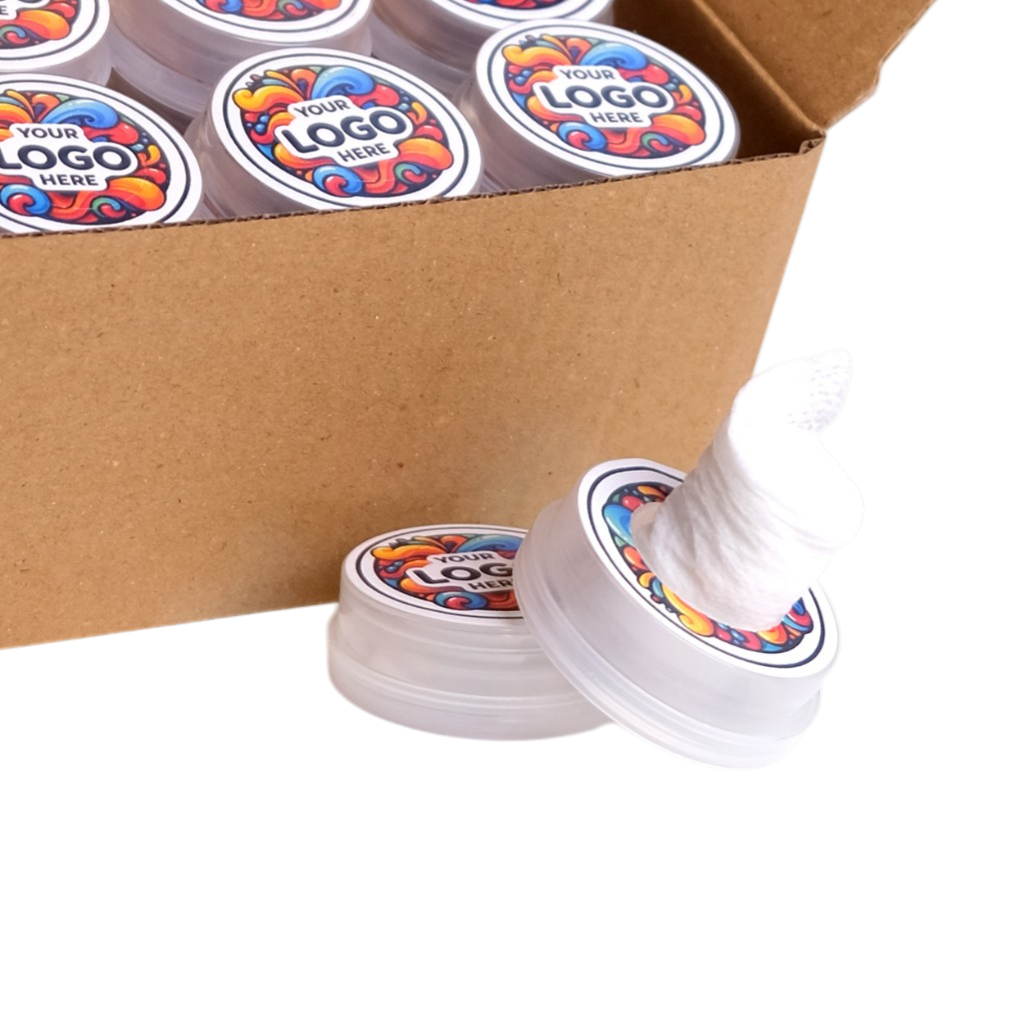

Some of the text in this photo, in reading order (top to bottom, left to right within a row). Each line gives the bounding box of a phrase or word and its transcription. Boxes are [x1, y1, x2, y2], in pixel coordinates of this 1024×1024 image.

[559, 69, 615, 80] YOUR
[541, 85, 667, 109] LOGO
[295, 100, 350, 117] YOUR
[590, 111, 643, 123] HERE
[17, 127, 78, 140] YOUR
[282, 110, 407, 153] LOGO
[337, 144, 390, 163] HERE
[40, 174, 98, 187] HERE
[435, 553, 495, 563] YOUR
[413, 562, 513, 584] LOG
[468, 579, 513, 590] HER
